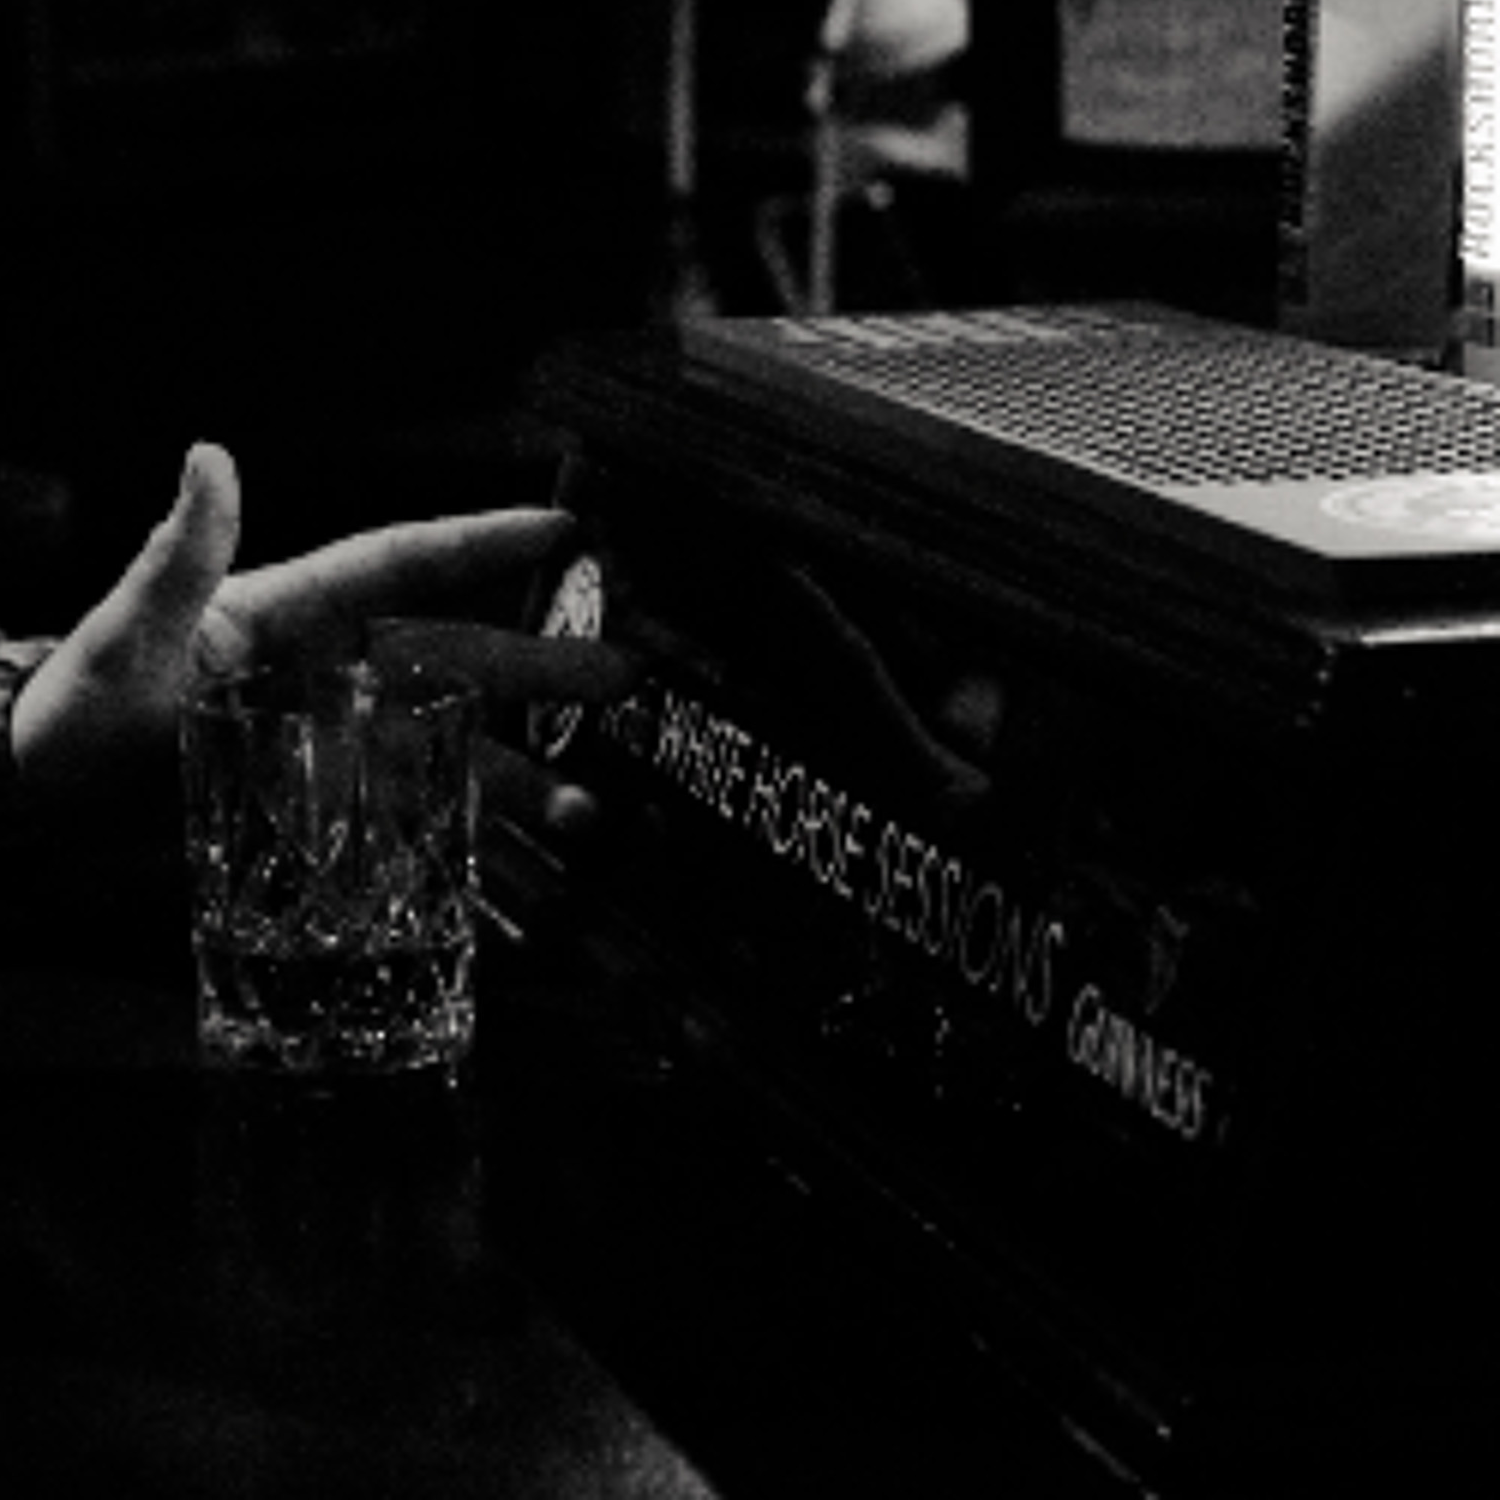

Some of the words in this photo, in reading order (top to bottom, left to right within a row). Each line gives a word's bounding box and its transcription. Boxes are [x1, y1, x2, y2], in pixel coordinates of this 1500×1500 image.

[743, 742, 873, 900] HORSE
[863, 820, 1066, 1028] SESSIONS
[1066, 981, 1214, 1143] GUINNESS
